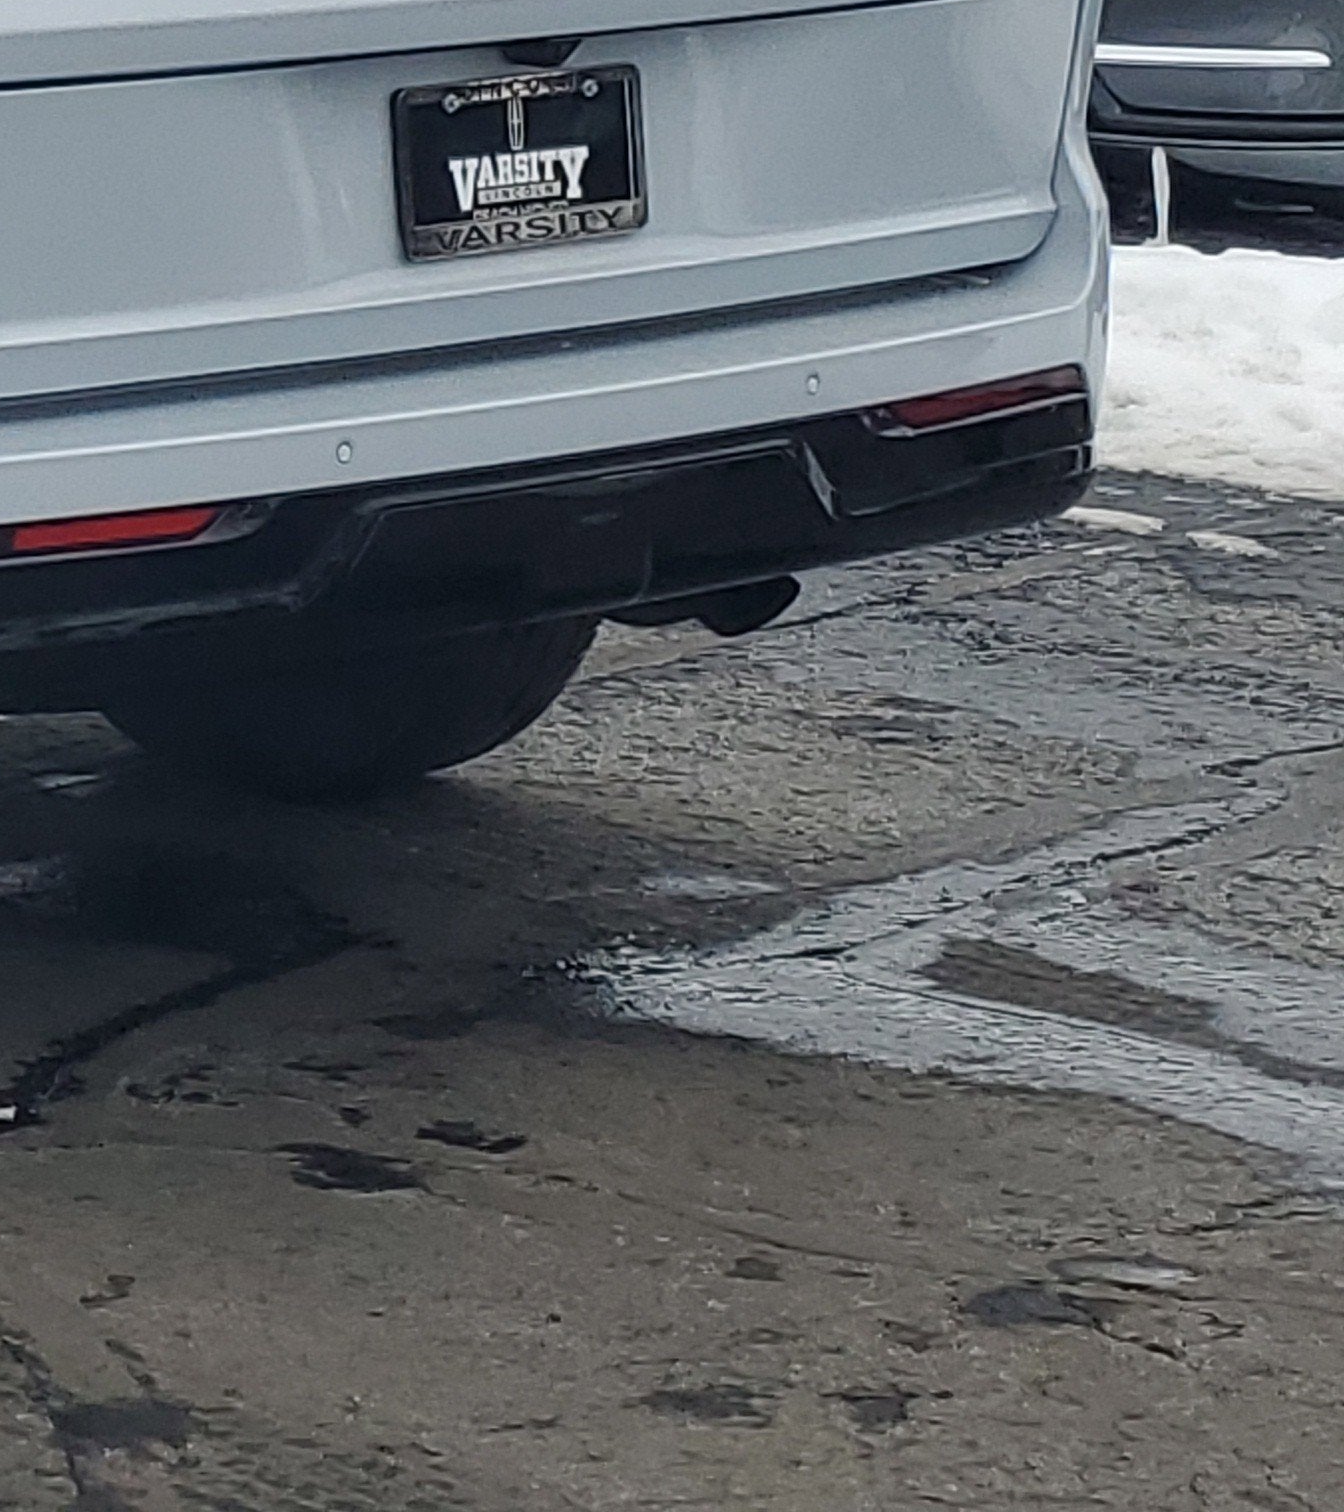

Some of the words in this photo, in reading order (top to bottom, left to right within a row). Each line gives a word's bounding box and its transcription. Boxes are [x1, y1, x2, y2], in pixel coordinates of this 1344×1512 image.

[447, 144, 590, 213] VARSITY
[483, 185, 555, 202] LINCOLN
[436, 205, 624, 251] VARSITY
